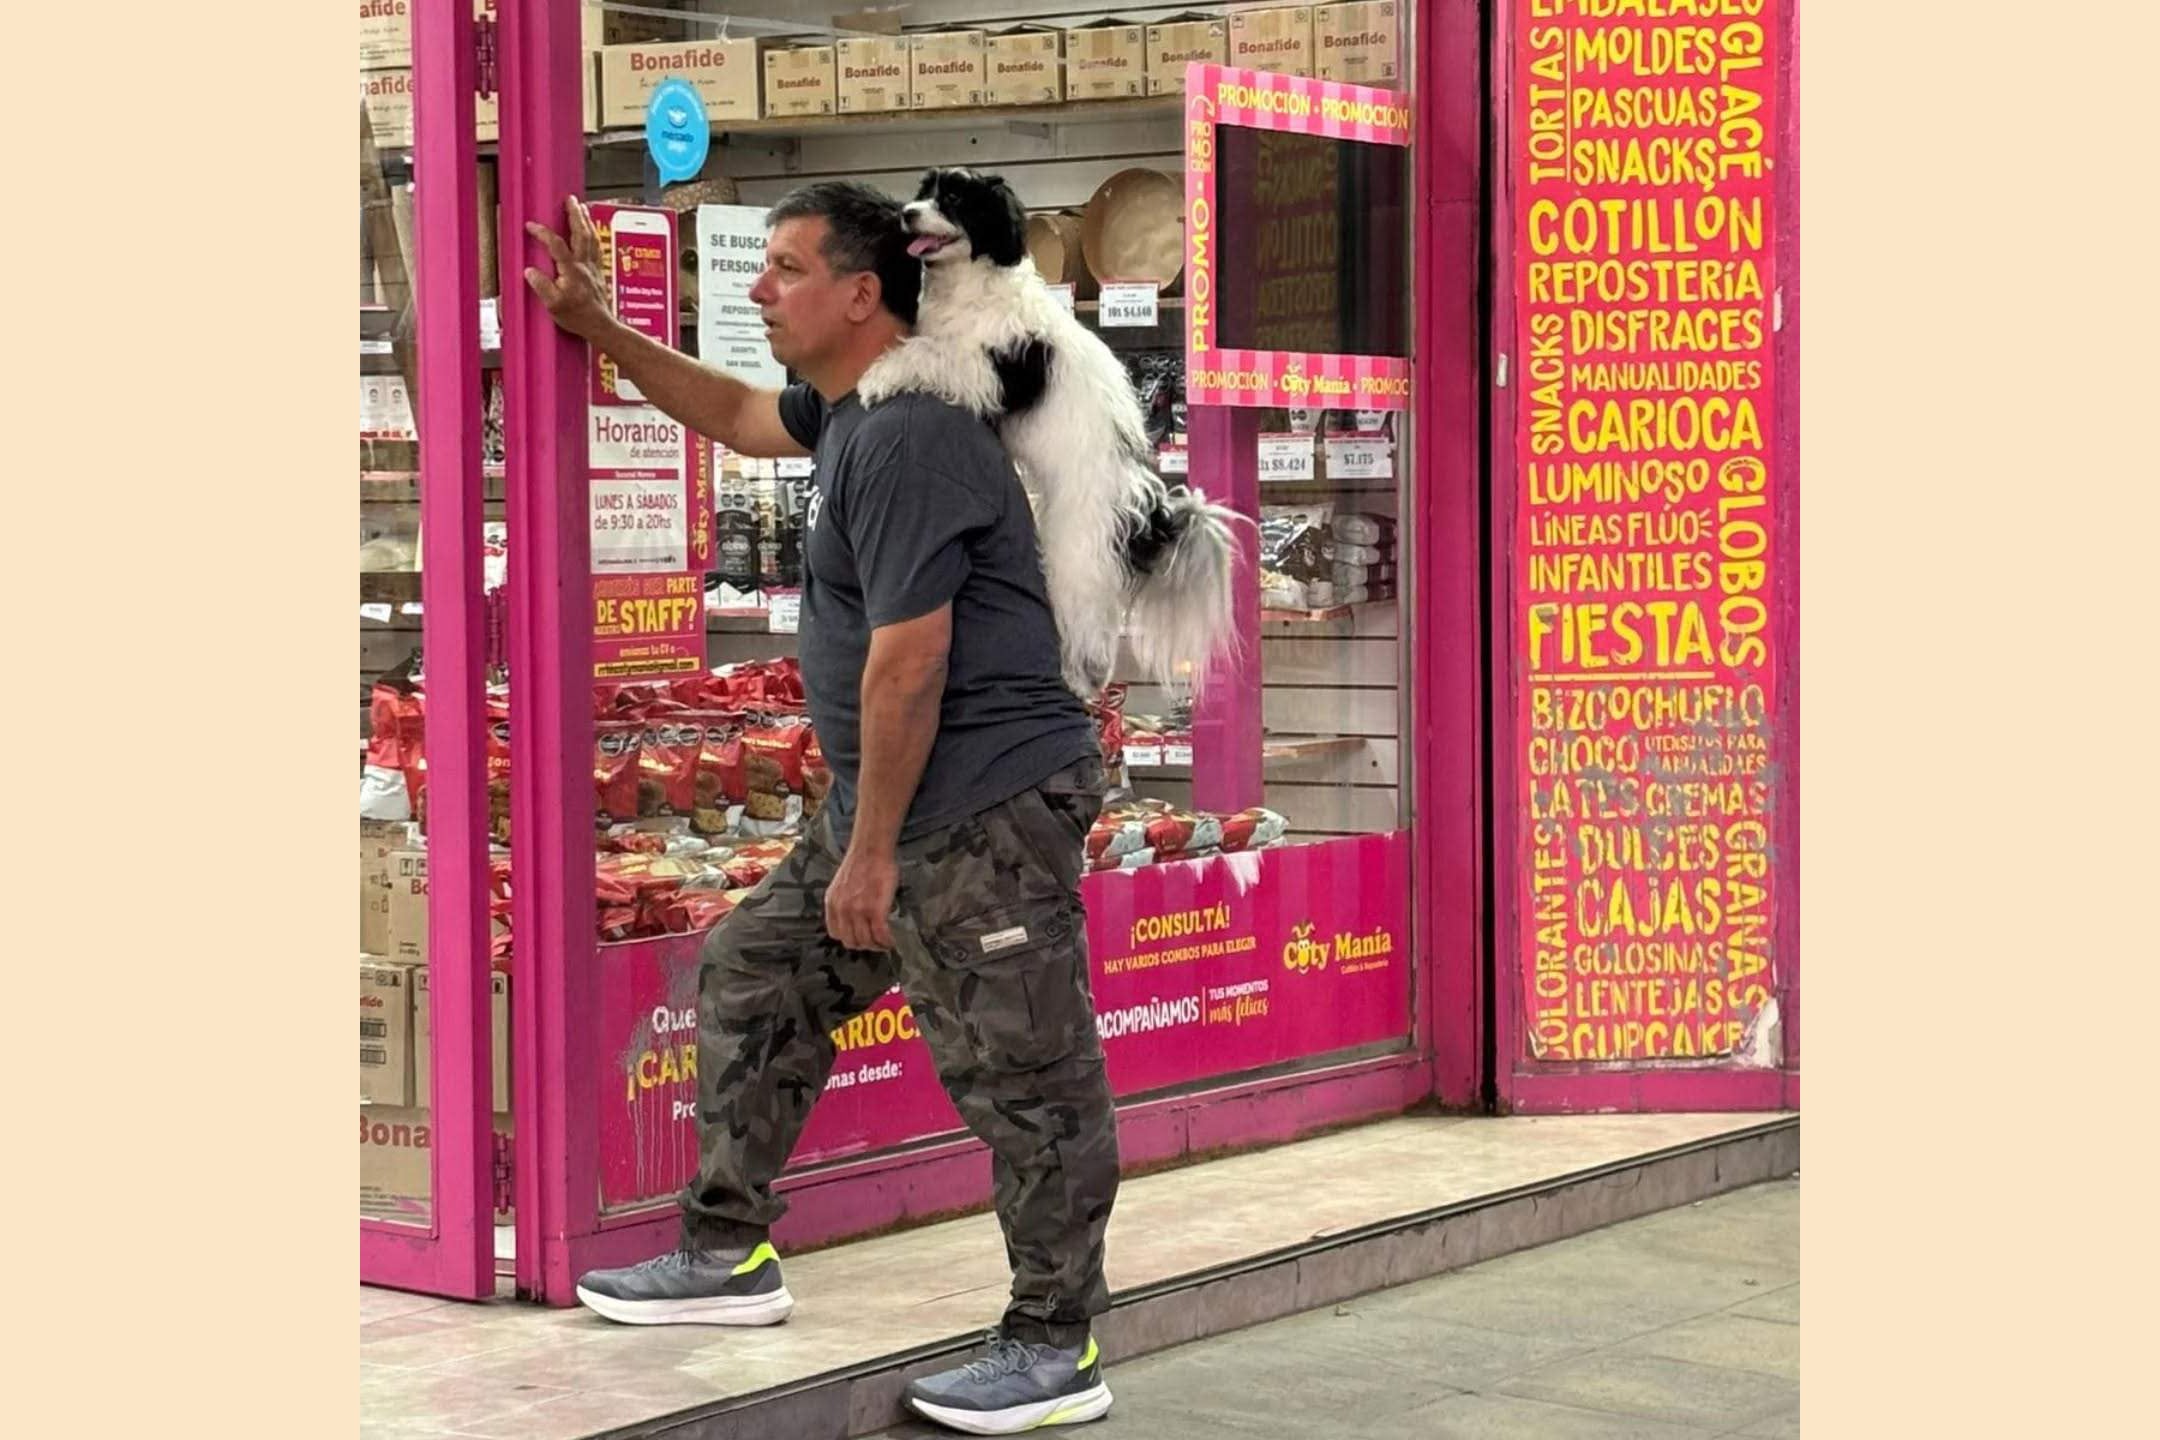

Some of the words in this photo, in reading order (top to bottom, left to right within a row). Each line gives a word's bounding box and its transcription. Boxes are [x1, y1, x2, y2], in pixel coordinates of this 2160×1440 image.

[1160, 48, 1213, 63] Bonafide
[1237, 38, 1301, 54] Bonafide
[1323, 31, 1387, 49] Bonafide
[1575, 26, 1717, 76] MOLDES
[630, 49, 726, 71] Bonafide
[844, 65, 900, 79] Bonafide
[918, 61, 974, 75] Bonafide
[997, 60, 1044, 74] Bonafide
[776, 77, 821, 89] Bonafide
[1718, 21, 1774, 181] GLACÉ
[1217, 82, 1311, 116] PROMOCIÓN
[1320, 96, 1410, 129] PROMOCIÓN
[1529, 27, 1566, 185] TORTAS
[1572, 86, 1718, 129] PASCUAS
[1573, 138, 1717, 187] SNACKS
[710, 234, 727, 248] SE
[1191, 198, 1210, 352] PROMO
[1528, 259, 1765, 304] REPOSTERÍA
[1570, 308, 1764, 355] DISFRACES
[1191, 369, 1269, 391] PROMOCIÓN
[1530, 313, 1565, 455] SNACKS
[1571, 360, 1762, 392] MANUALIDADES
[595, 416, 679, 443] Horarios
[1568, 396, 1764, 454] CARIOCA
[1528, 458, 1711, 505] LUMINOSO
[594, 493, 624, 510] LUNES
[627, 493, 634, 510] A
[594, 514, 608, 530] de
[637, 517, 644, 530] a
[1531, 511, 1622, 546] LÍNEAS
[1528, 552, 1713, 593] INFANTILES
[1718, 456, 1768, 667] GLOBOS
[667, 576, 698, 594] PARTE
[597, 599, 618, 624] DE
[620, 597, 698, 634] STAFF?
[1528, 601, 1714, 670] FIESTA
[1528, 734, 1640, 775] CHOCO
[1130, 901, 1231, 950] ¡CONSULTÁ!
[1576, 877, 1722, 938] CAJAS
[1725, 820, 1768, 1009] GRANAS
[1334, 926, 1392, 962] Manía
[1574, 941, 1723, 976] GOLOSINAS
[1104, 960, 1127, 974] HAY
[1125, 952, 1160, 971] VARIOS
[1208, 987, 1225, 1000] TUS
[1576, 977, 1723, 1017] LENTEJAS
[829, 1004, 921, 1052] ARIOC
[858, 1060, 903, 1084] desde:
